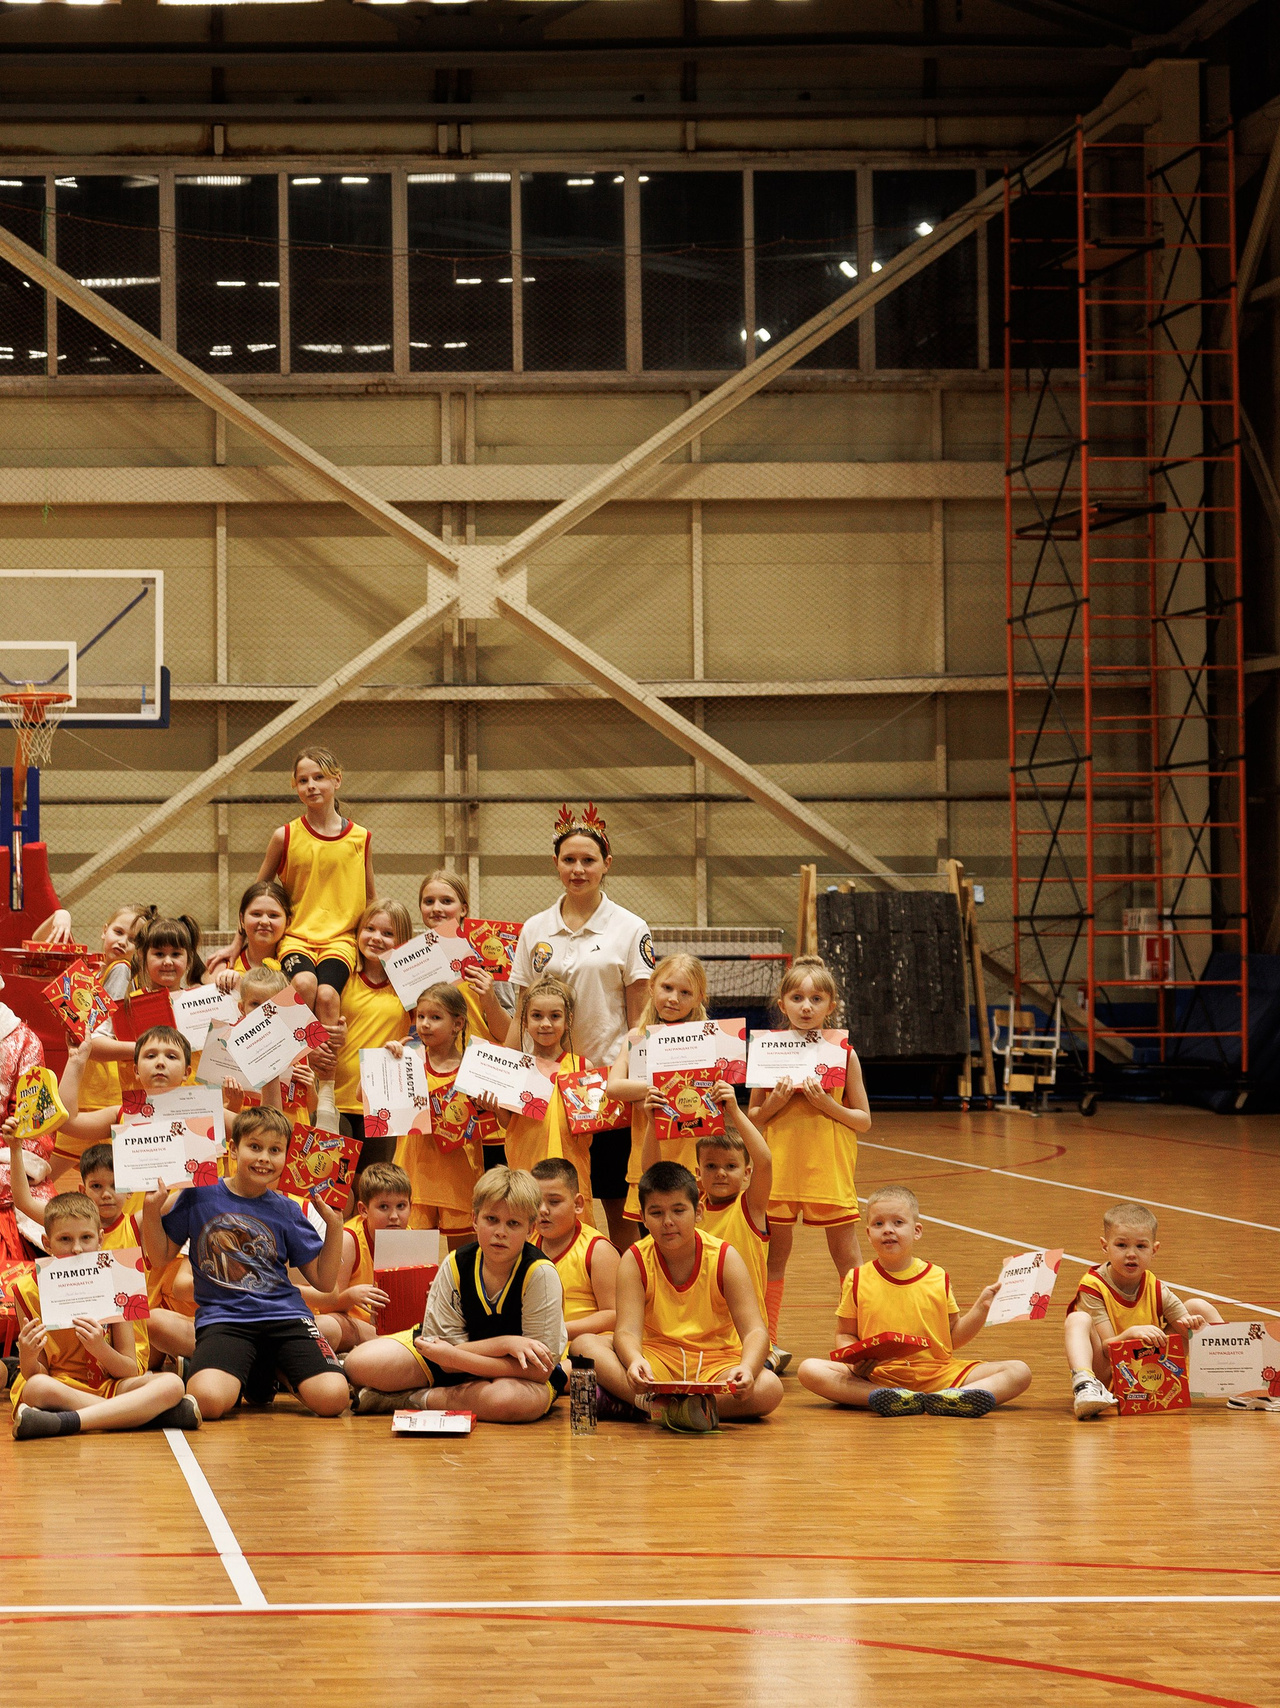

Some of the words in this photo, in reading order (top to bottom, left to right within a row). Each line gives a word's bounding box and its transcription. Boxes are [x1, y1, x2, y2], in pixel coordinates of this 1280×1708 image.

[393, 946, 432, 969] ГРАМОТА
[181, 995, 223, 1010] ГРАМОТА
[234, 1018, 272, 1047] ГРАМОТА
[658, 1034, 705, 1045] ГРАМОТА
[761, 1041, 807, 1049] ГРАМОТА
[477, 1050, 519, 1070] ГРАМОТА
[405, 1056, 415, 1098] ГРАМОТА
[124, 1134, 173, 1146] ГРАМОТА
[50, 1267, 100, 1280] ГРАМОТА
[1004, 1266, 1032, 1278] ГРАМОТА
[1202, 1338, 1251, 1346] ГРАМОТА
